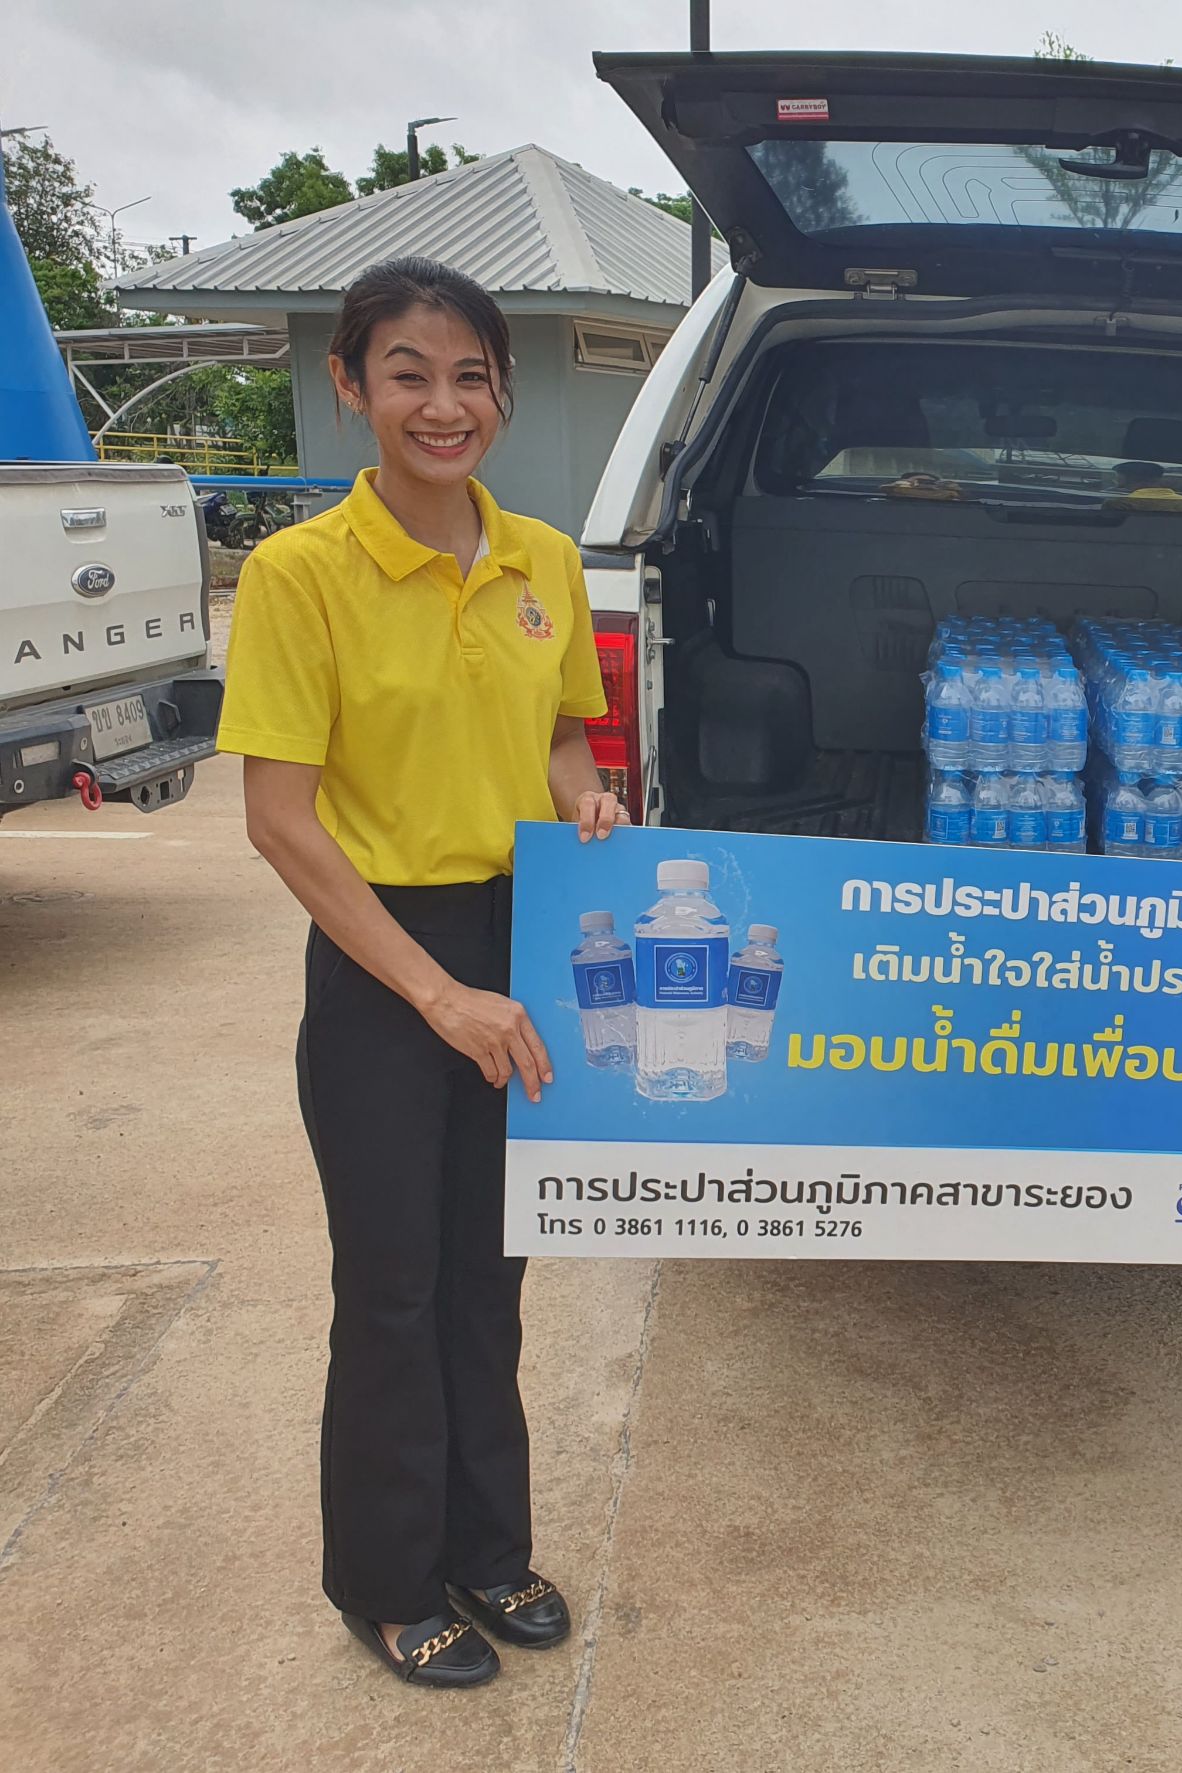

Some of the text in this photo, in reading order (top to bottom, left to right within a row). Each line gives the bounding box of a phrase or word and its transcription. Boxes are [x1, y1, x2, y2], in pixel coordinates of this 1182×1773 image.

[87, 569, 111, 589] Ford
[116, 700, 144, 726] 8409
[538, 1168, 1133, 1214] การประปาส่วนภูมิภาคสาขาระยอง
[538, 1213, 863, 1239] โทร 0 3861 1116, 0 3861 5276
